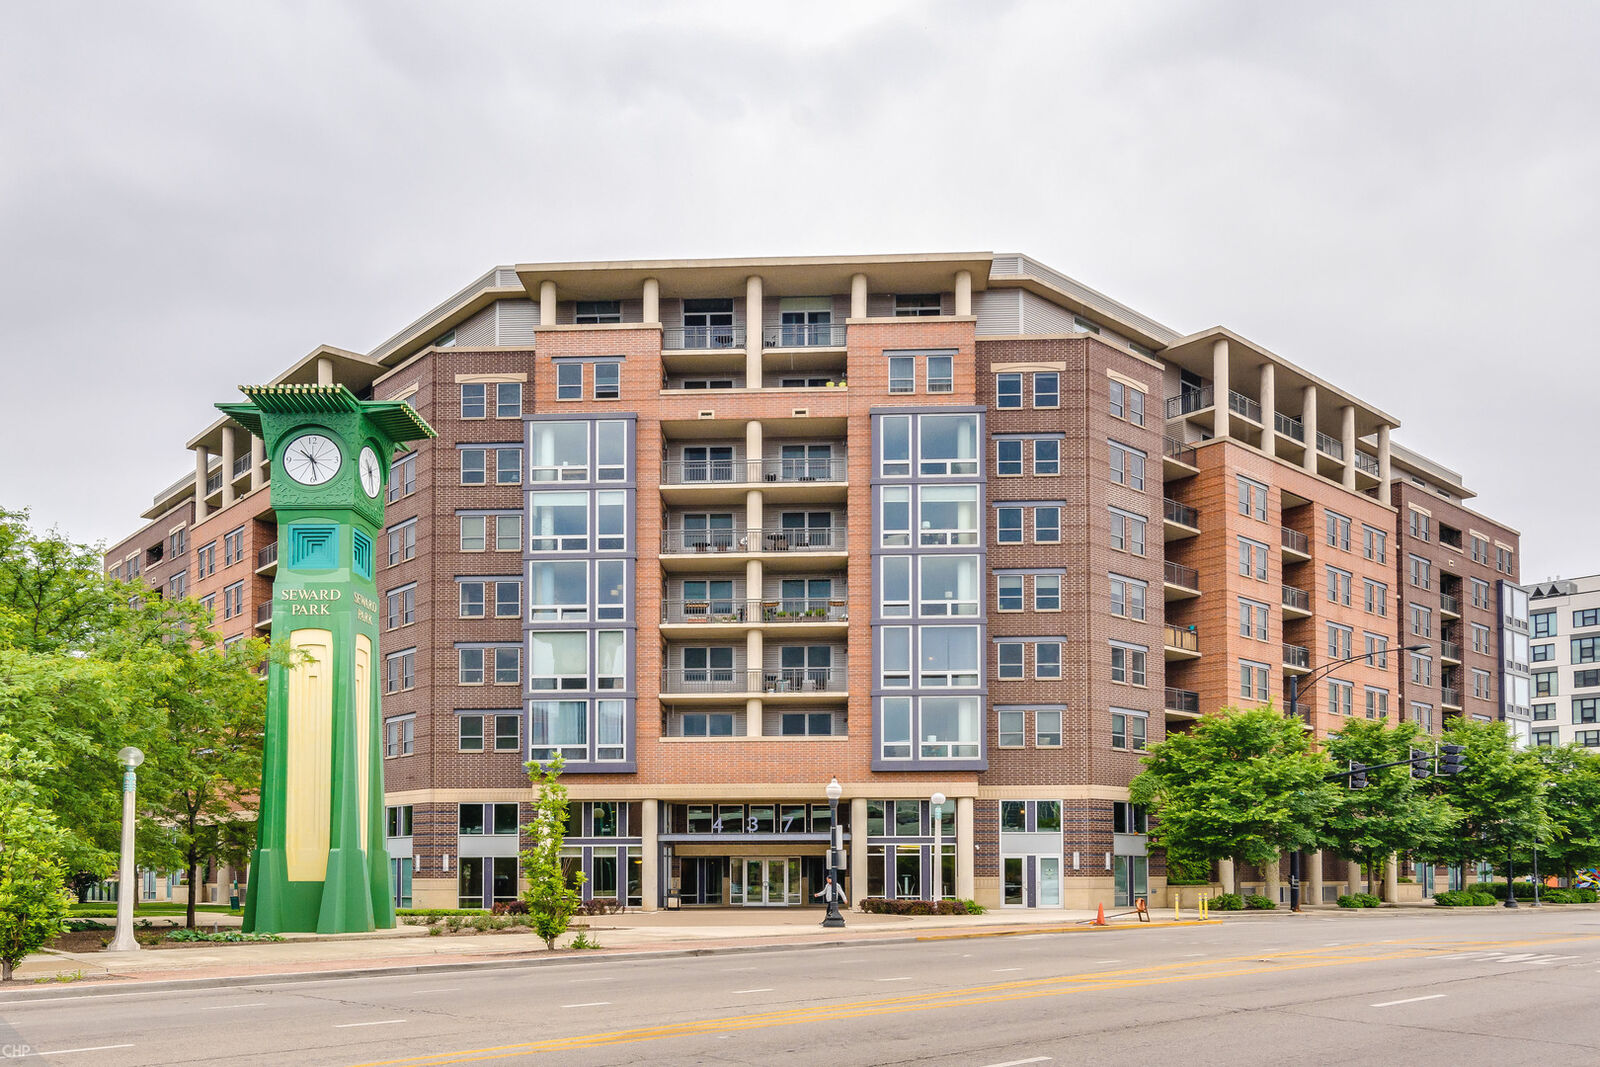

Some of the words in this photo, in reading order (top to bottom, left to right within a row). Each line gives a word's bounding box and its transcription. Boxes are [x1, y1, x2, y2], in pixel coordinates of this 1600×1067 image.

[281, 589, 341, 600] SEWARD
[353, 591, 377, 613] SEWARD
[292, 604, 331, 616] PARK
[357, 607, 373, 625] PARK
